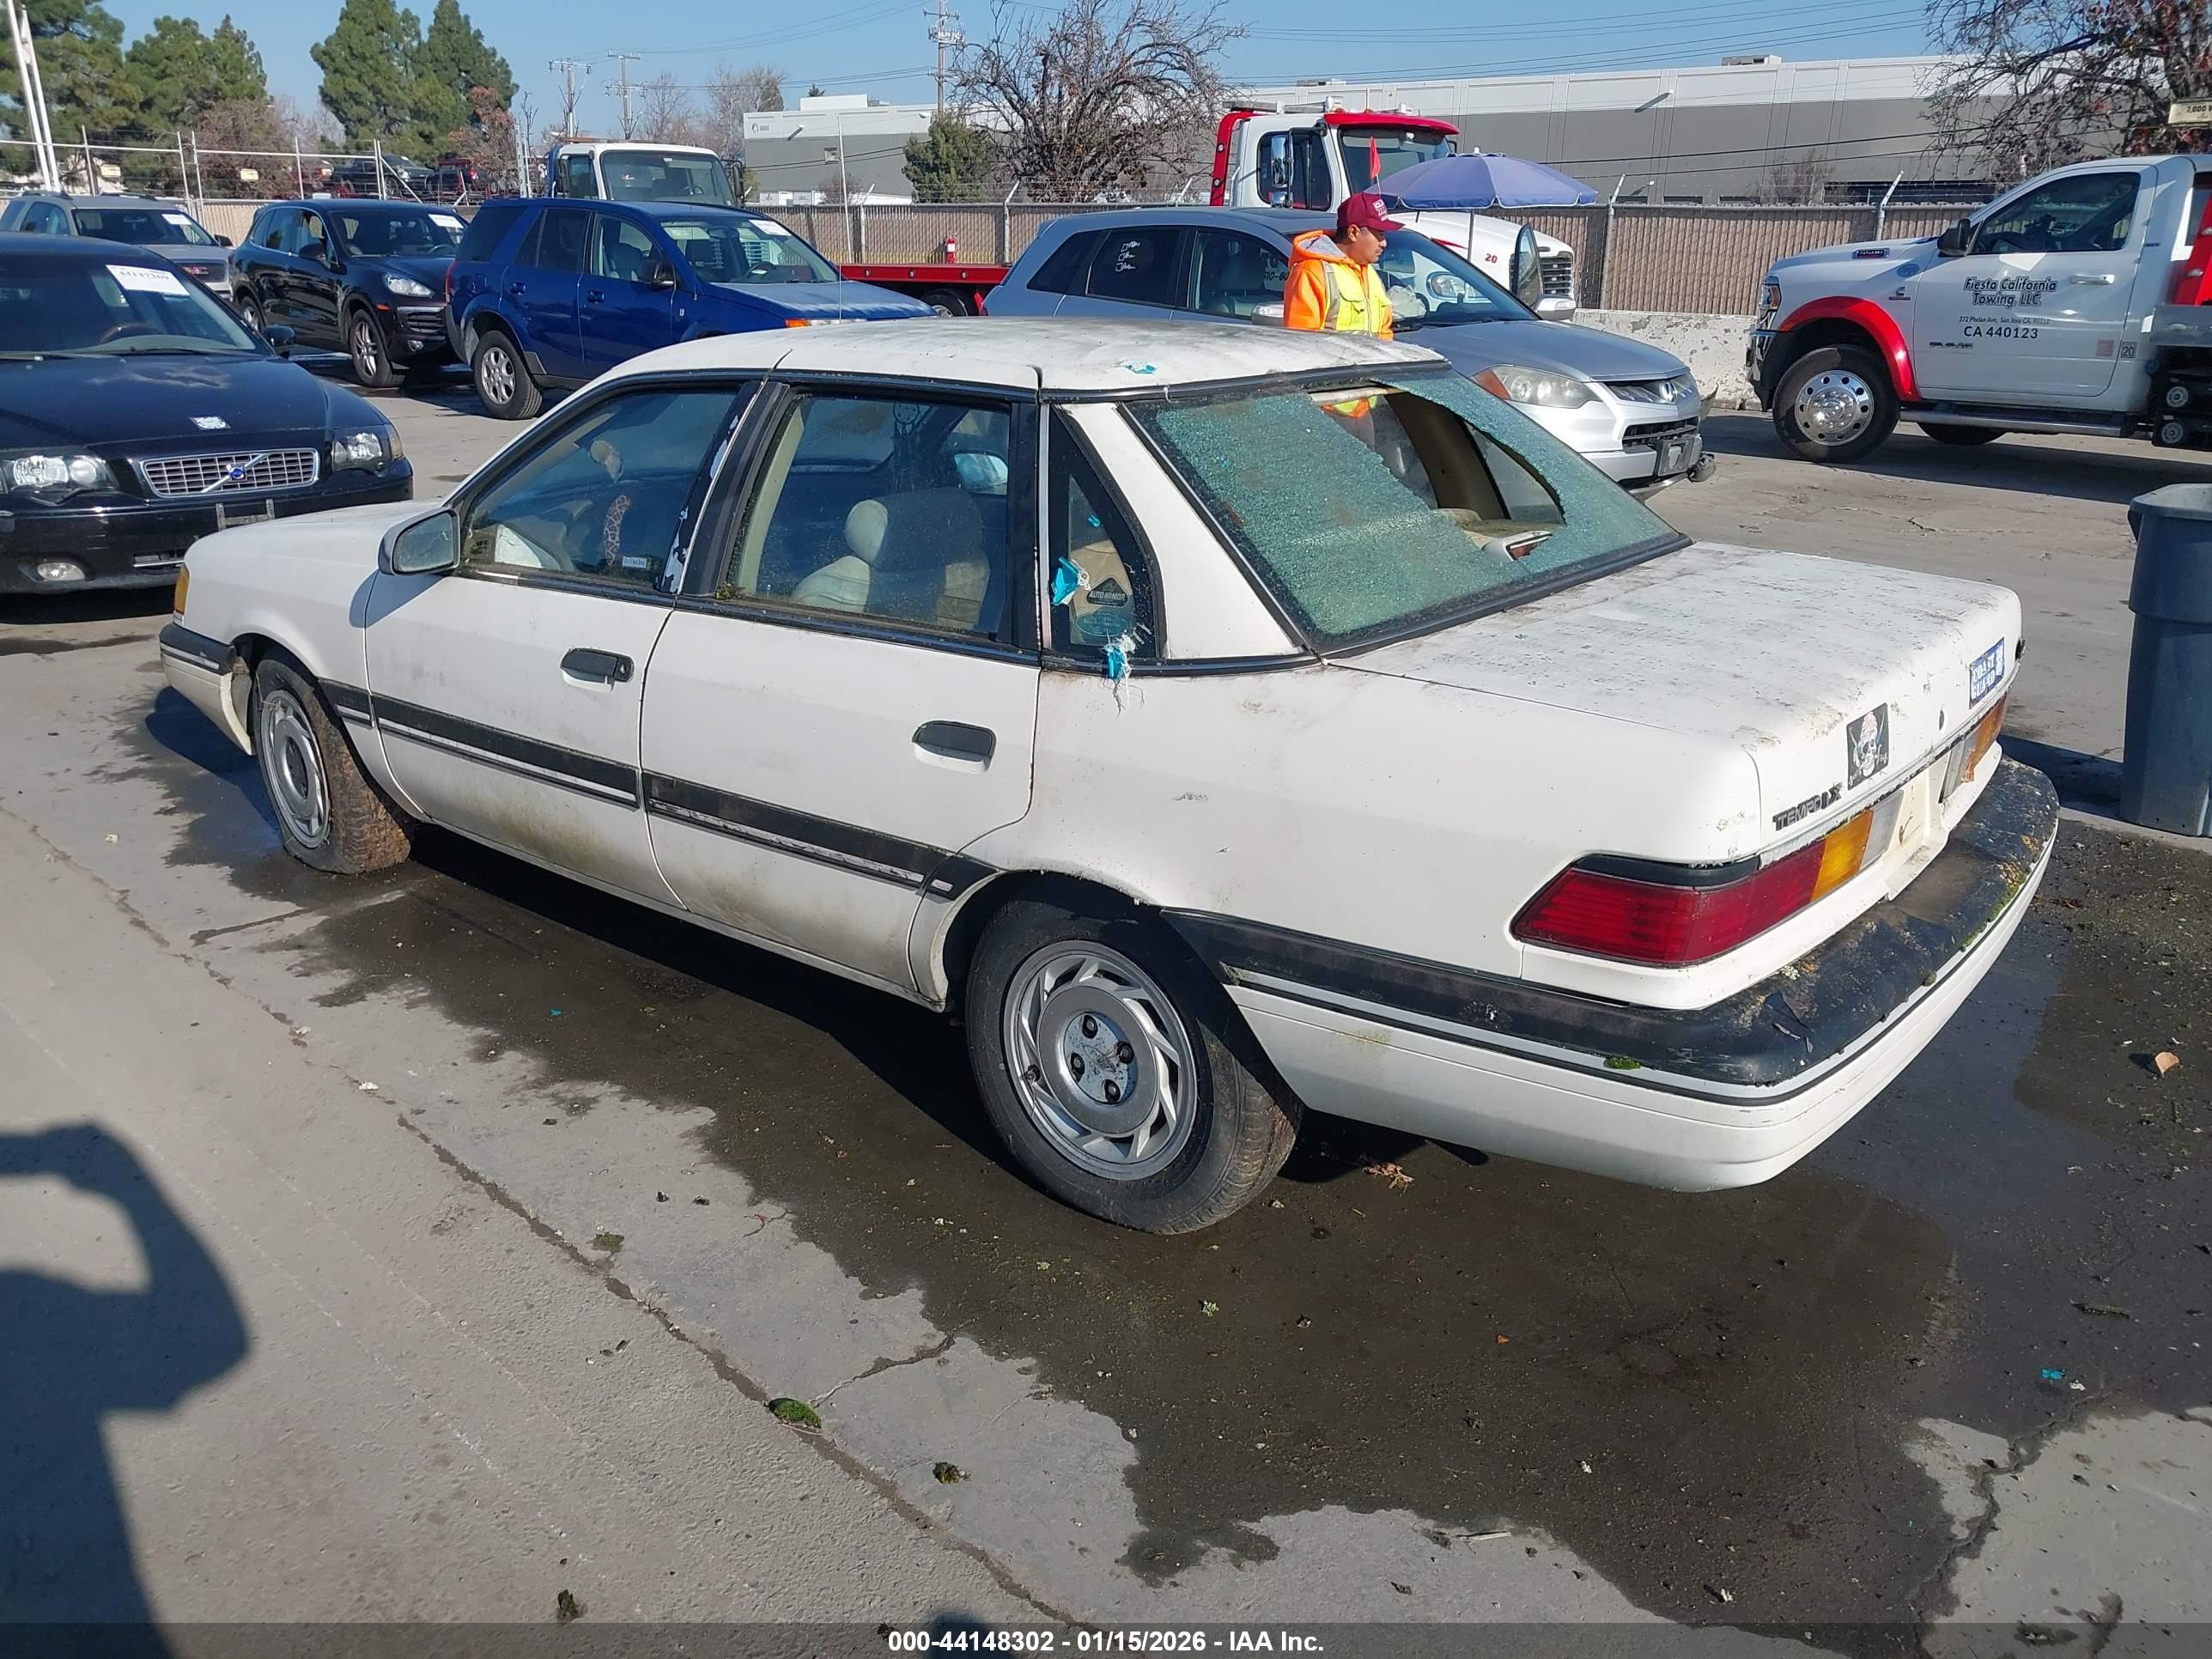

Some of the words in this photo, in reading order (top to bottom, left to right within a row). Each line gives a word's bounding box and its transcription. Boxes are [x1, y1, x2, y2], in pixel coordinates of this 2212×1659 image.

[1485, 253, 1498, 263] 20
[1964, 276, 1997, 291] Fiesta
[1999, 276, 2057, 292] California
[1972, 292, 2017, 309] Towing,
[1964, 326, 1983, 337] CA
[1985, 326, 2039, 339] 440123
[2123, 345, 2135, 357] 20
[1104, 592, 1126, 601] ARMOR
[1972, 653, 1996, 683] COAST
[1971, 671, 1995, 700] GUARD
[1772, 794, 1821, 831] TEMPO
